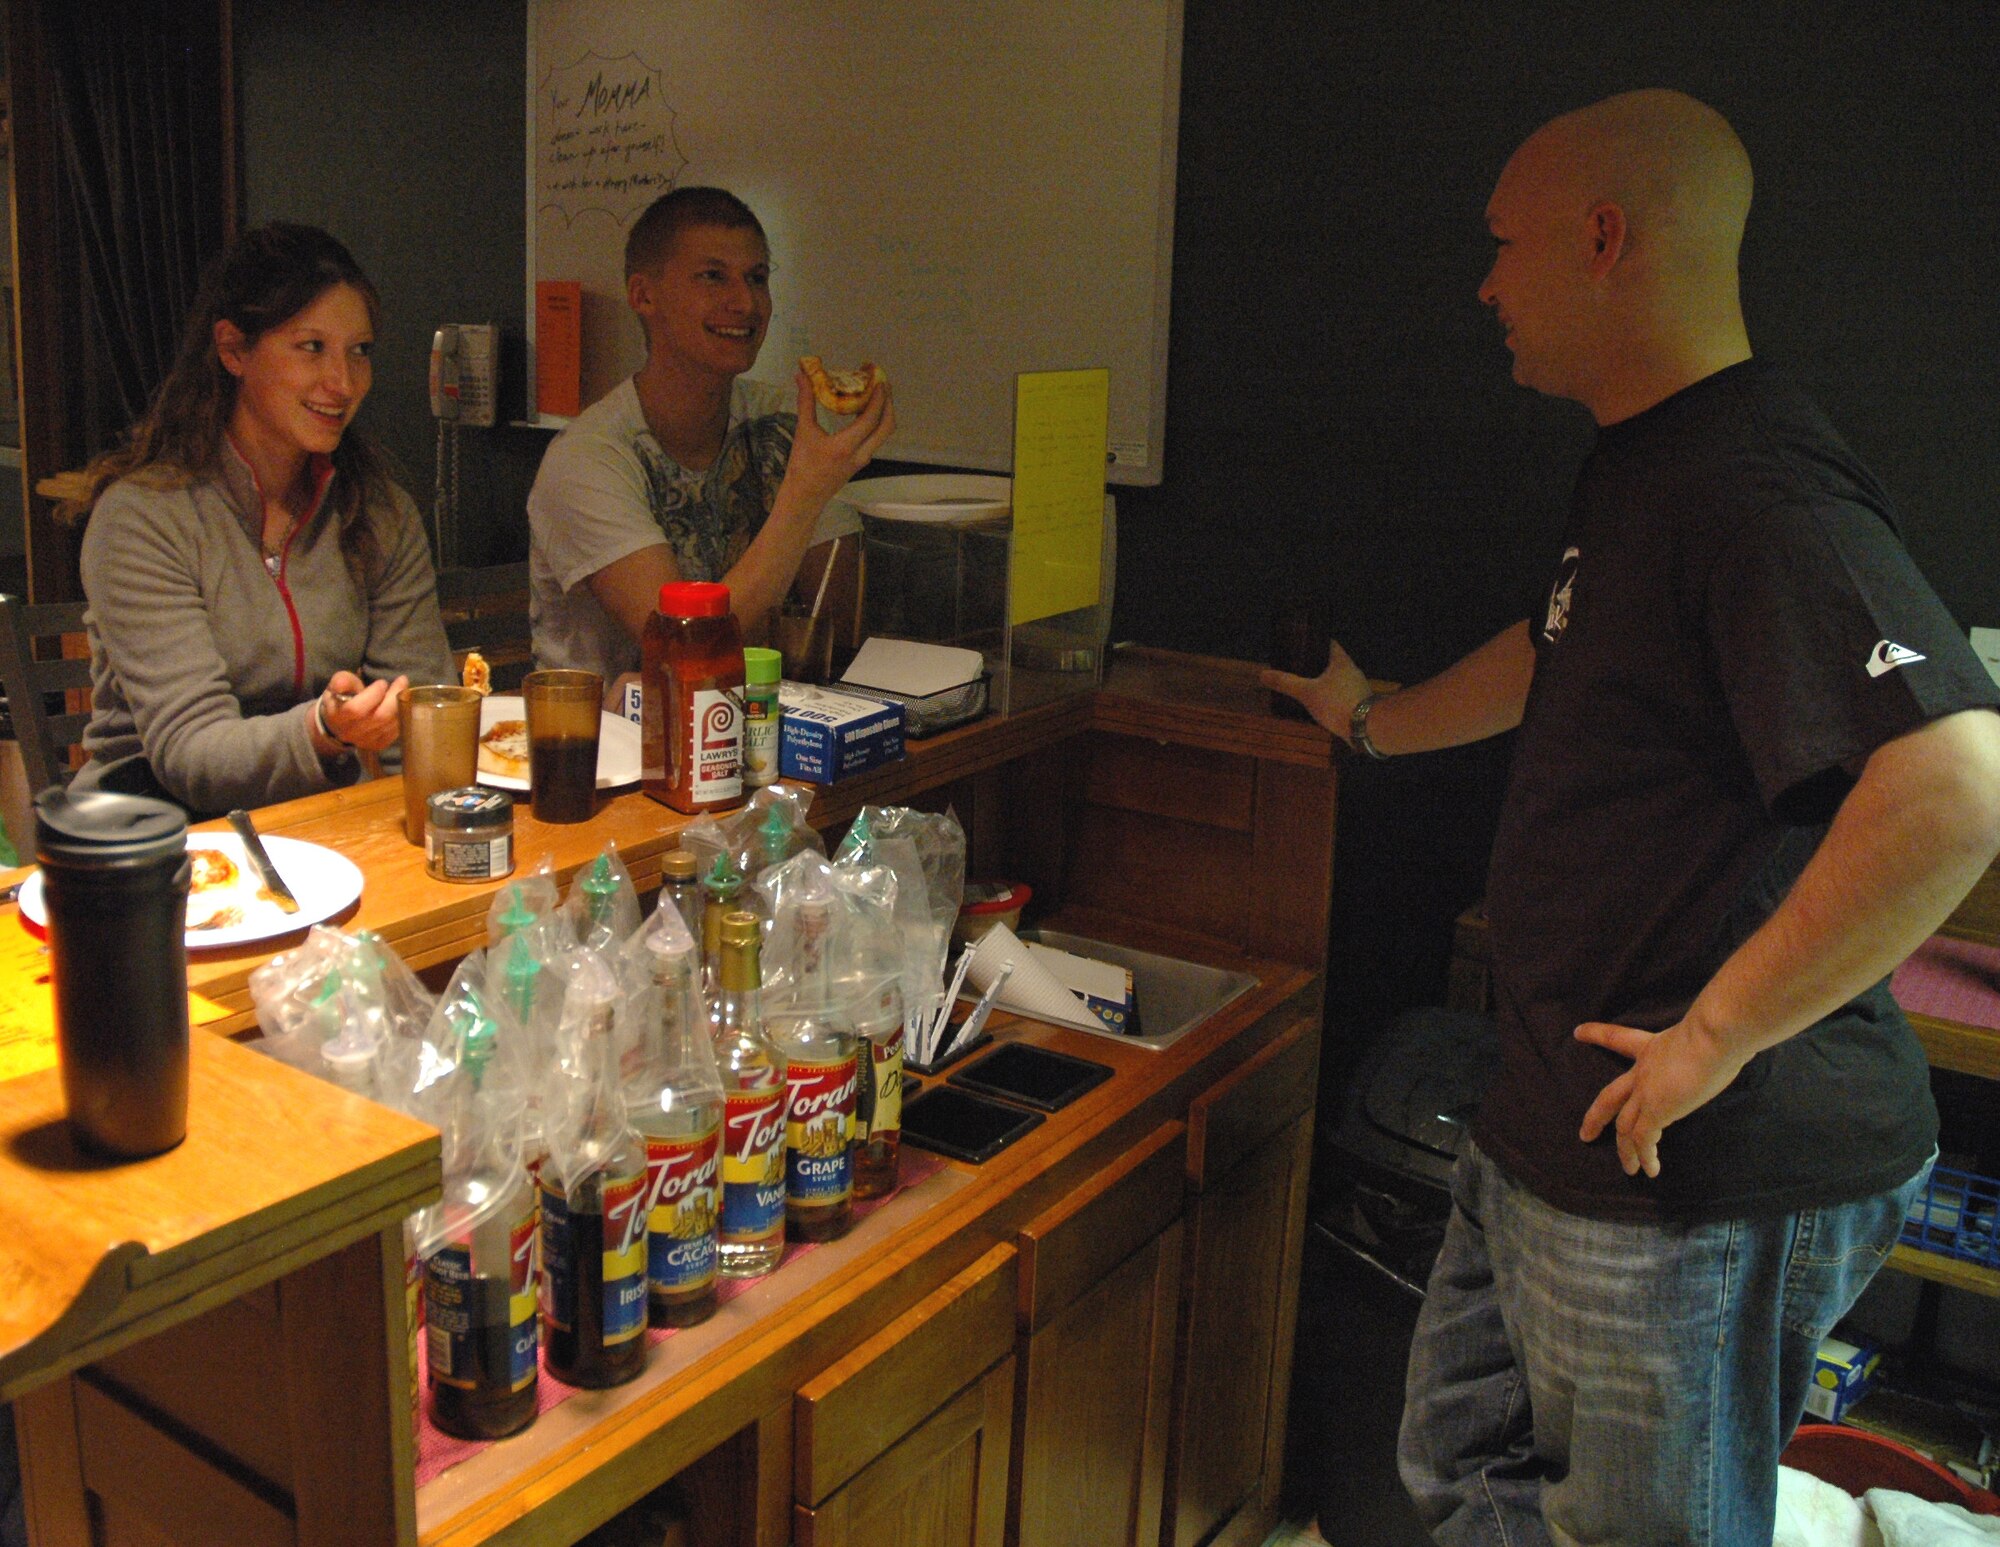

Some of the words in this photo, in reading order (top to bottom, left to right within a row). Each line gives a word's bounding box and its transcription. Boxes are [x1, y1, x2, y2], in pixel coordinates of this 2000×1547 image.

[797, 1156, 845, 1176] GRAPE
[812, 1173, 836, 1183] SYRUP
[667, 1239, 715, 1266] CACAO
